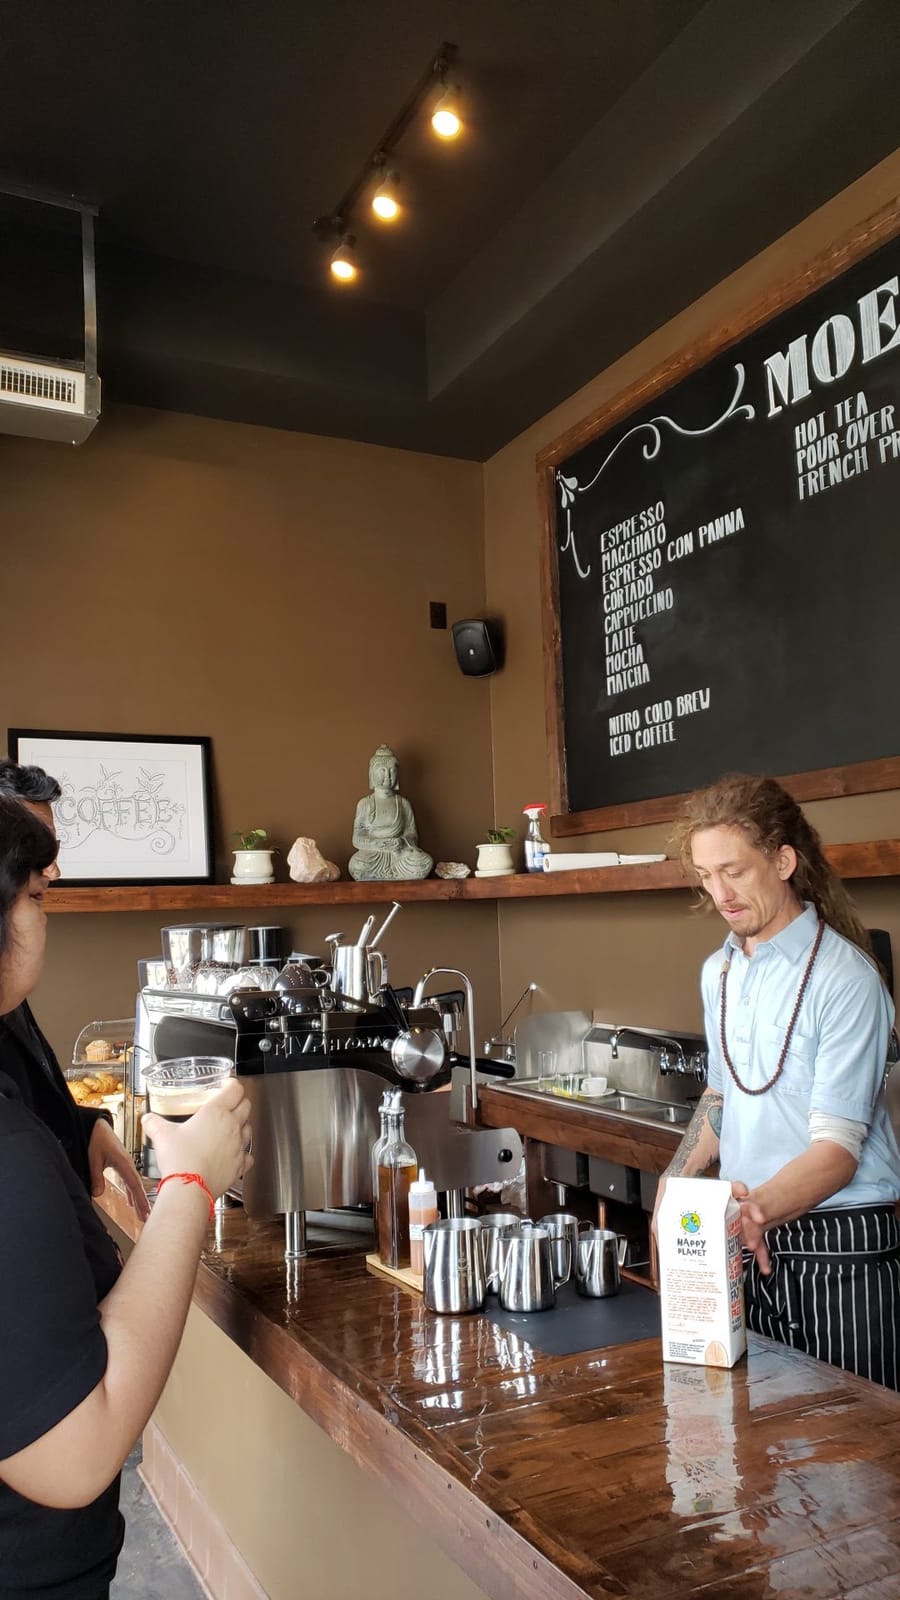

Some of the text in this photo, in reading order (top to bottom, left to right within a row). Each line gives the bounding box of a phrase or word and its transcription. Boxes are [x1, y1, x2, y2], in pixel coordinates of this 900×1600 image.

[763, 276, 900, 418] MOE
[794, 391, 868, 450] HOT TEA
[796, 404, 895, 474] POUR-OVER
[798, 445, 869, 500] FRENCH
[600, 501, 665, 553] ESPRESSO
[601, 522, 667, 574] MACCHIATO
[602, 507, 745, 595] ESPRESSO CON PANNA
[603, 574, 654, 614] CORTADO
[604, 587, 674, 635] CAPPUCCINO
[605, 625, 636, 655] LATTE
[605, 643, 645, 676] MOCHA
[606, 663, 650, 695] MATCHA
[608, 688, 710, 737] NITRO COLD BREW
[609, 721, 676, 756] ICED COFFEE
[54, 795, 173, 827] COFFEE
[677, 1247, 708, 1257] PLANET
